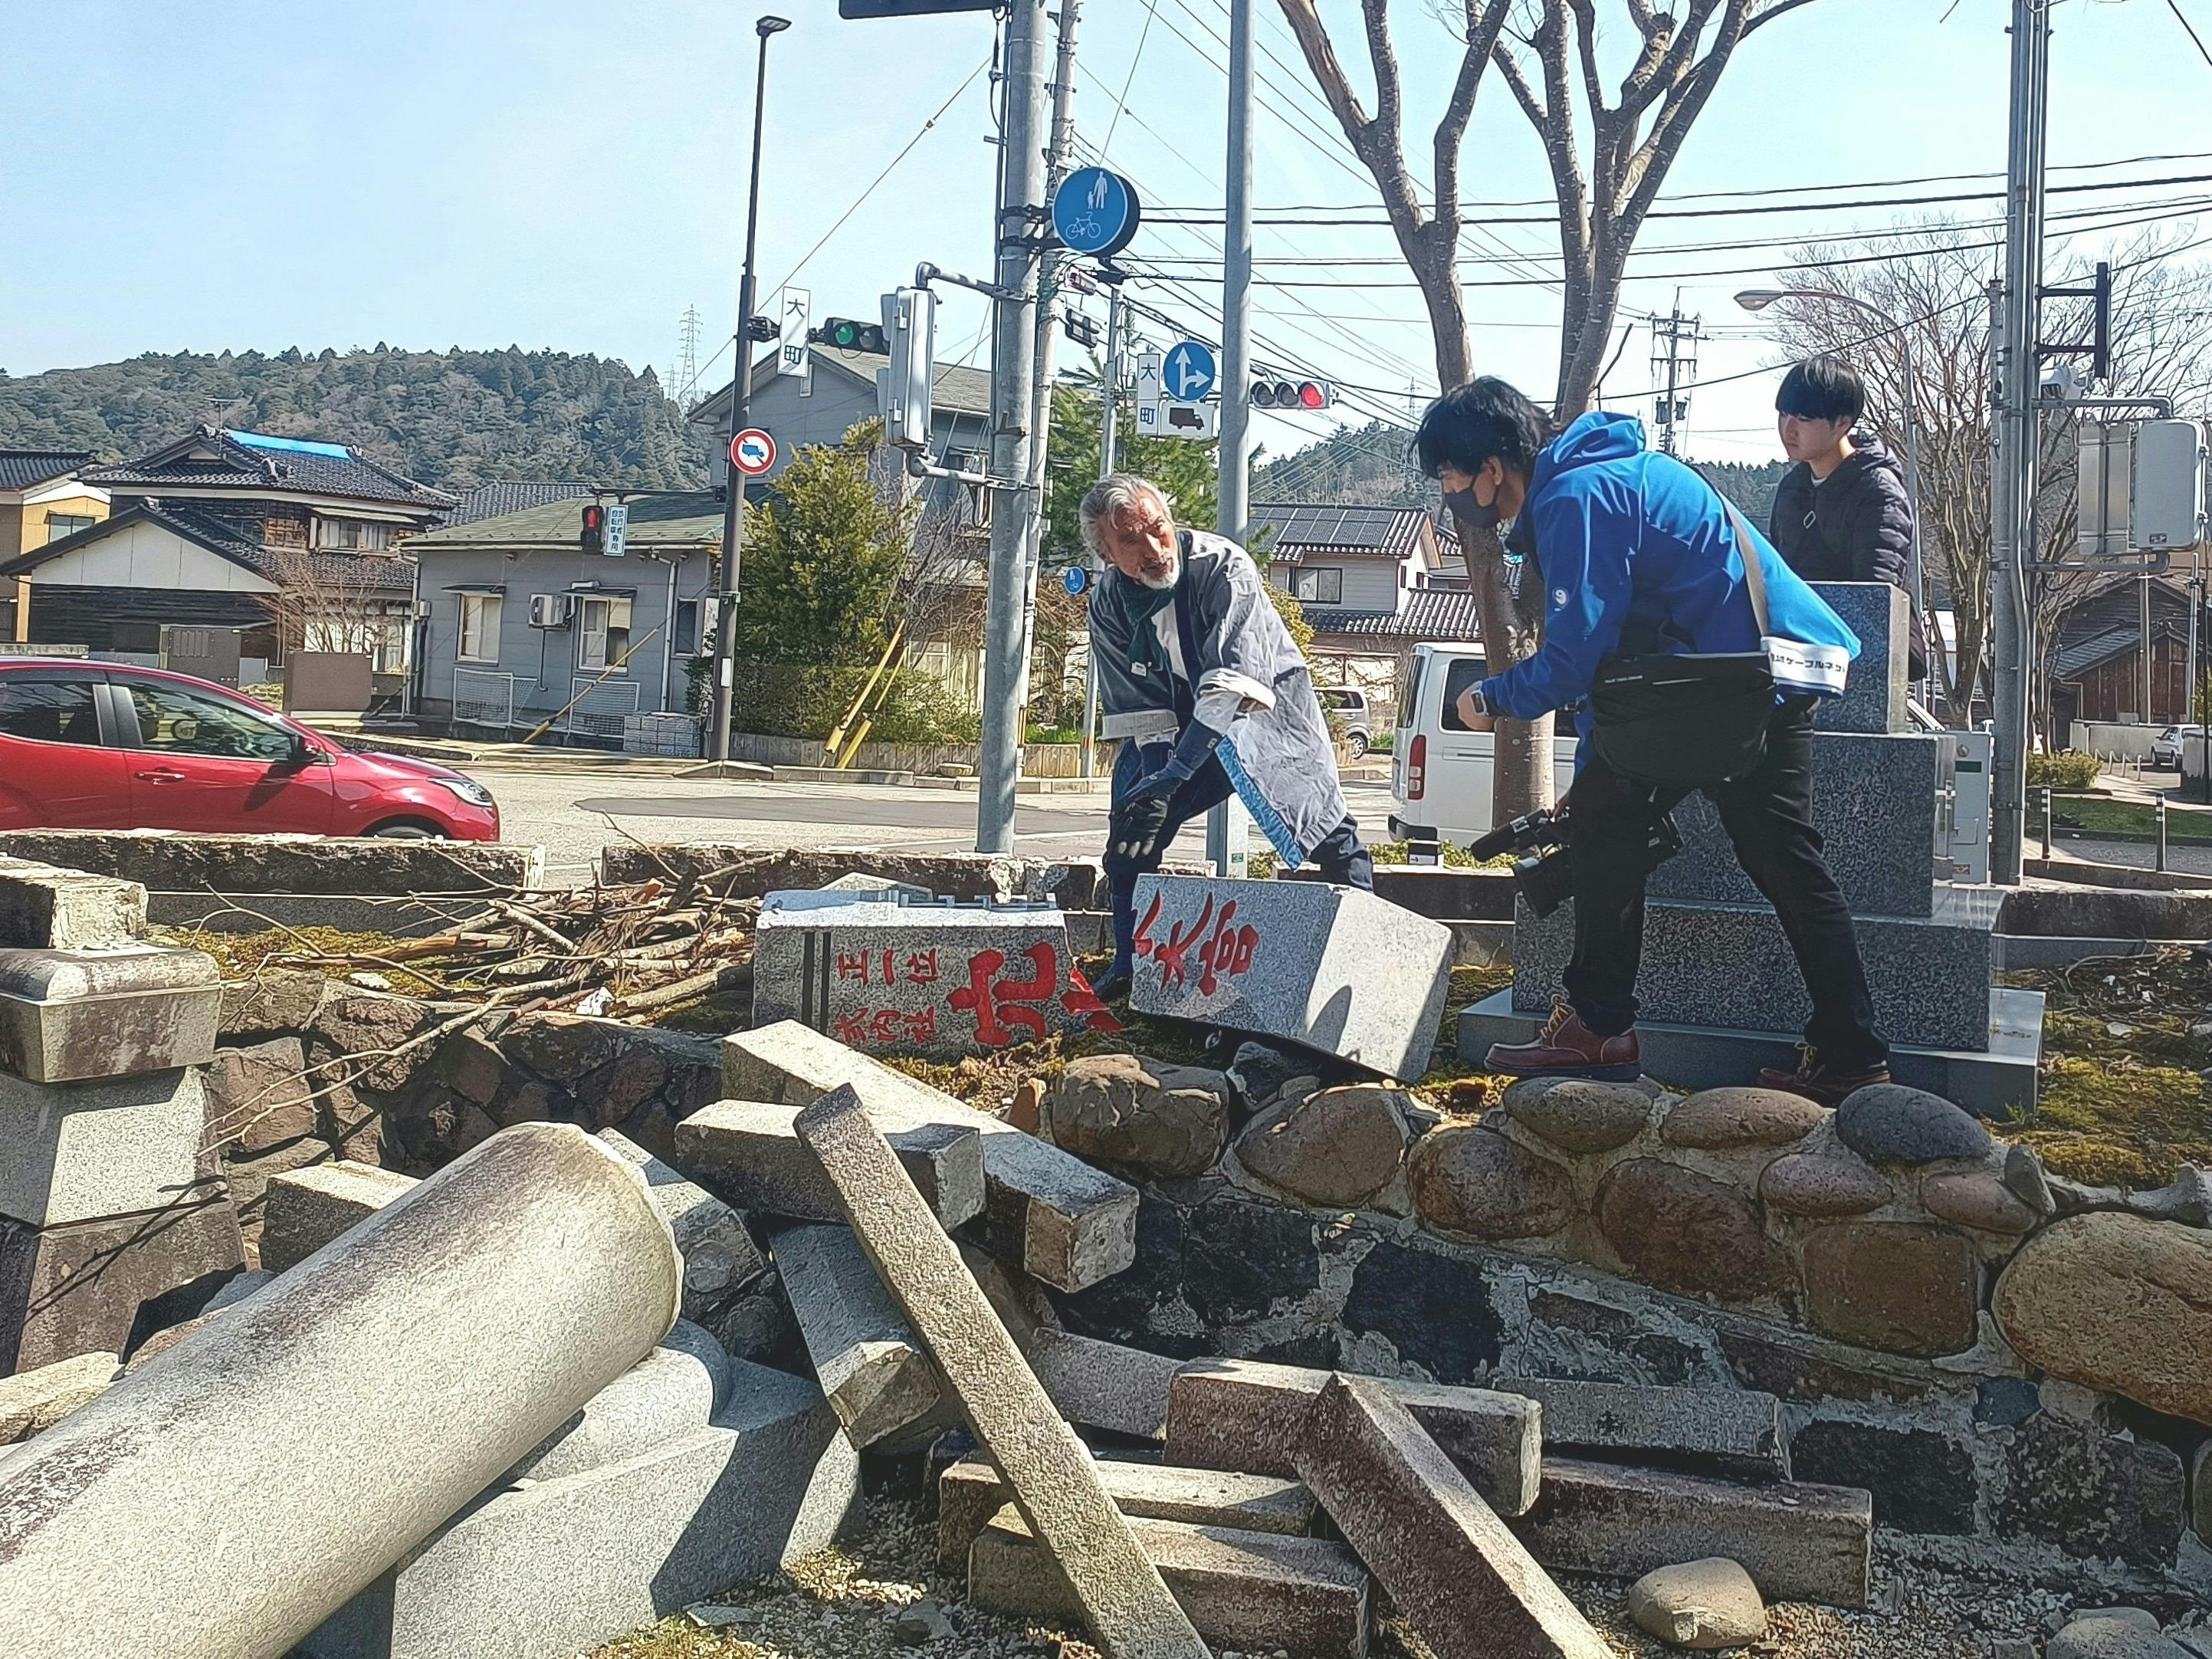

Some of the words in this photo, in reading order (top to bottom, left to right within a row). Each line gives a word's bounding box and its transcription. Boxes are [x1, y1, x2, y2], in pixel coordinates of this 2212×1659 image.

[786, 297, 806, 365] 大町
[1140, 363, 1157, 425] 大町
[837, 948, 939, 987] 正一位
[833, 1006, 937, 1044] 式内社
